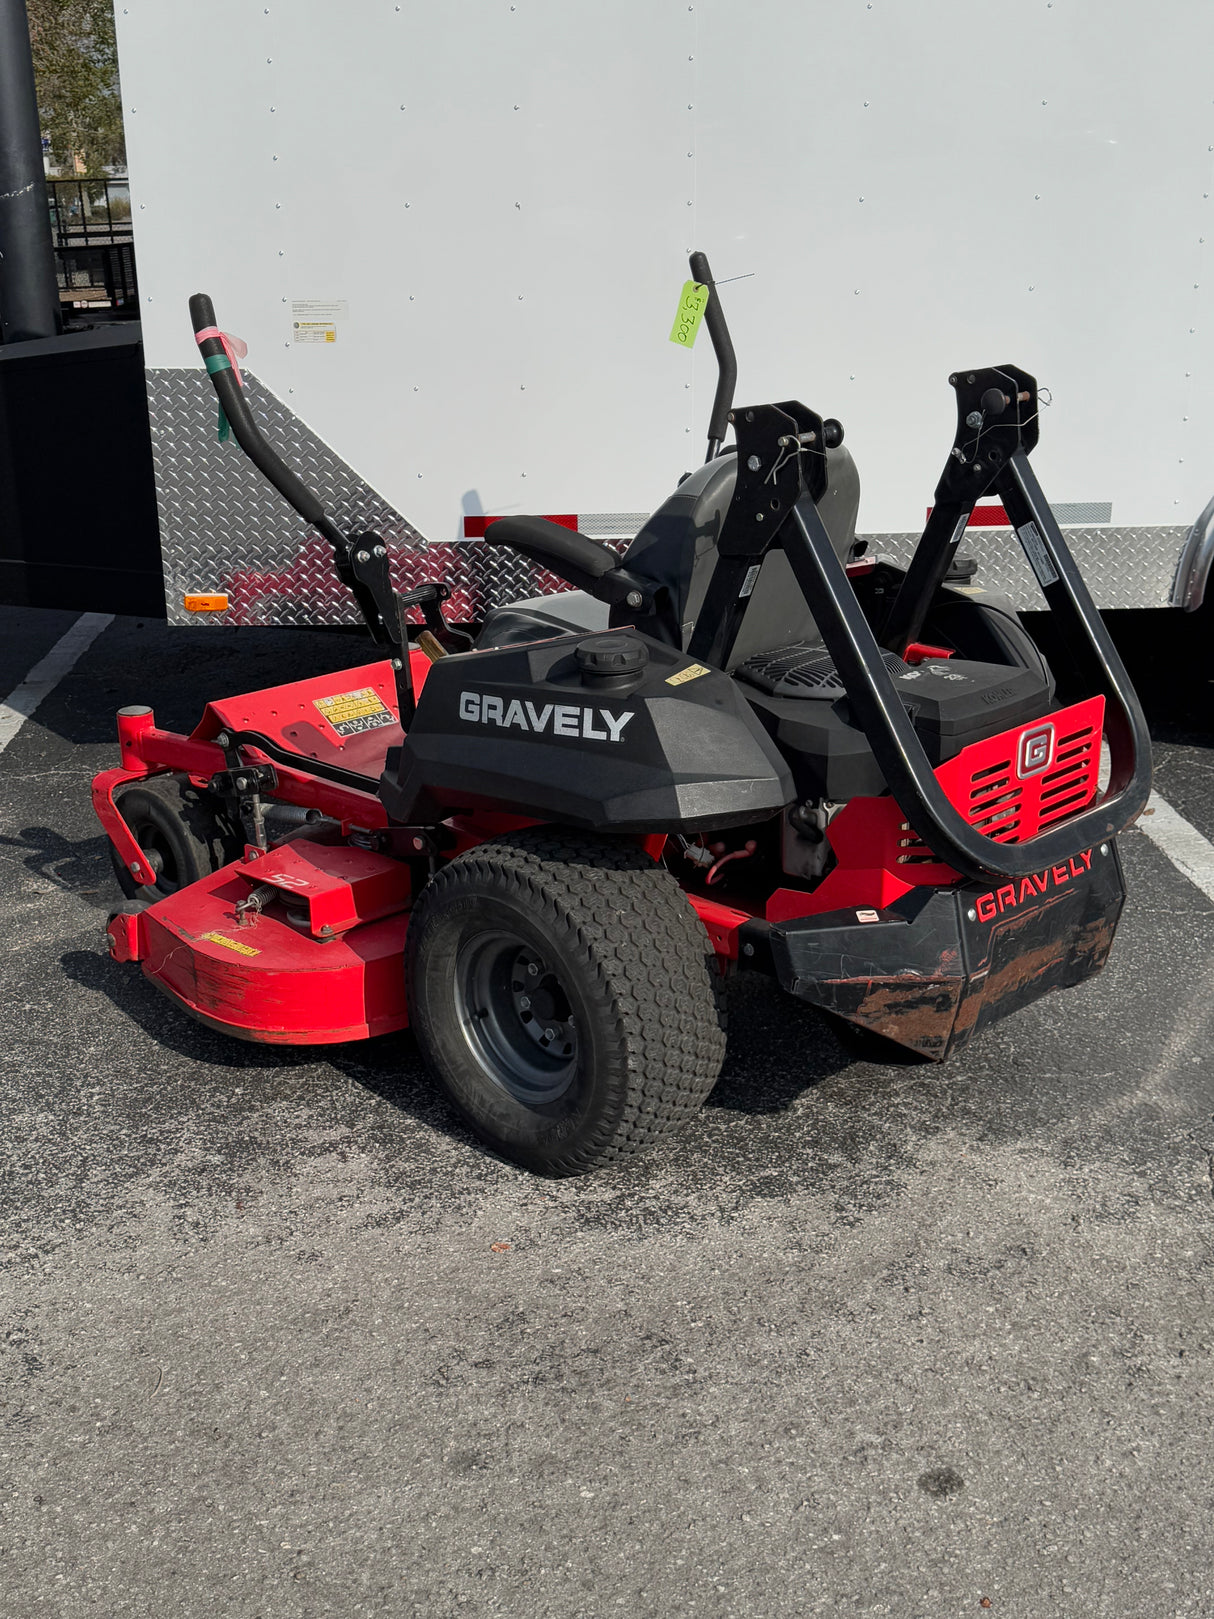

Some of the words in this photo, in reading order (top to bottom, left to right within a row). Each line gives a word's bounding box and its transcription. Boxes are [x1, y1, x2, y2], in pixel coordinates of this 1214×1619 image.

[459, 691, 635, 742] GRAVELY
[262, 873, 309, 889] 52
[975, 848, 1092, 923] GRAVELY
